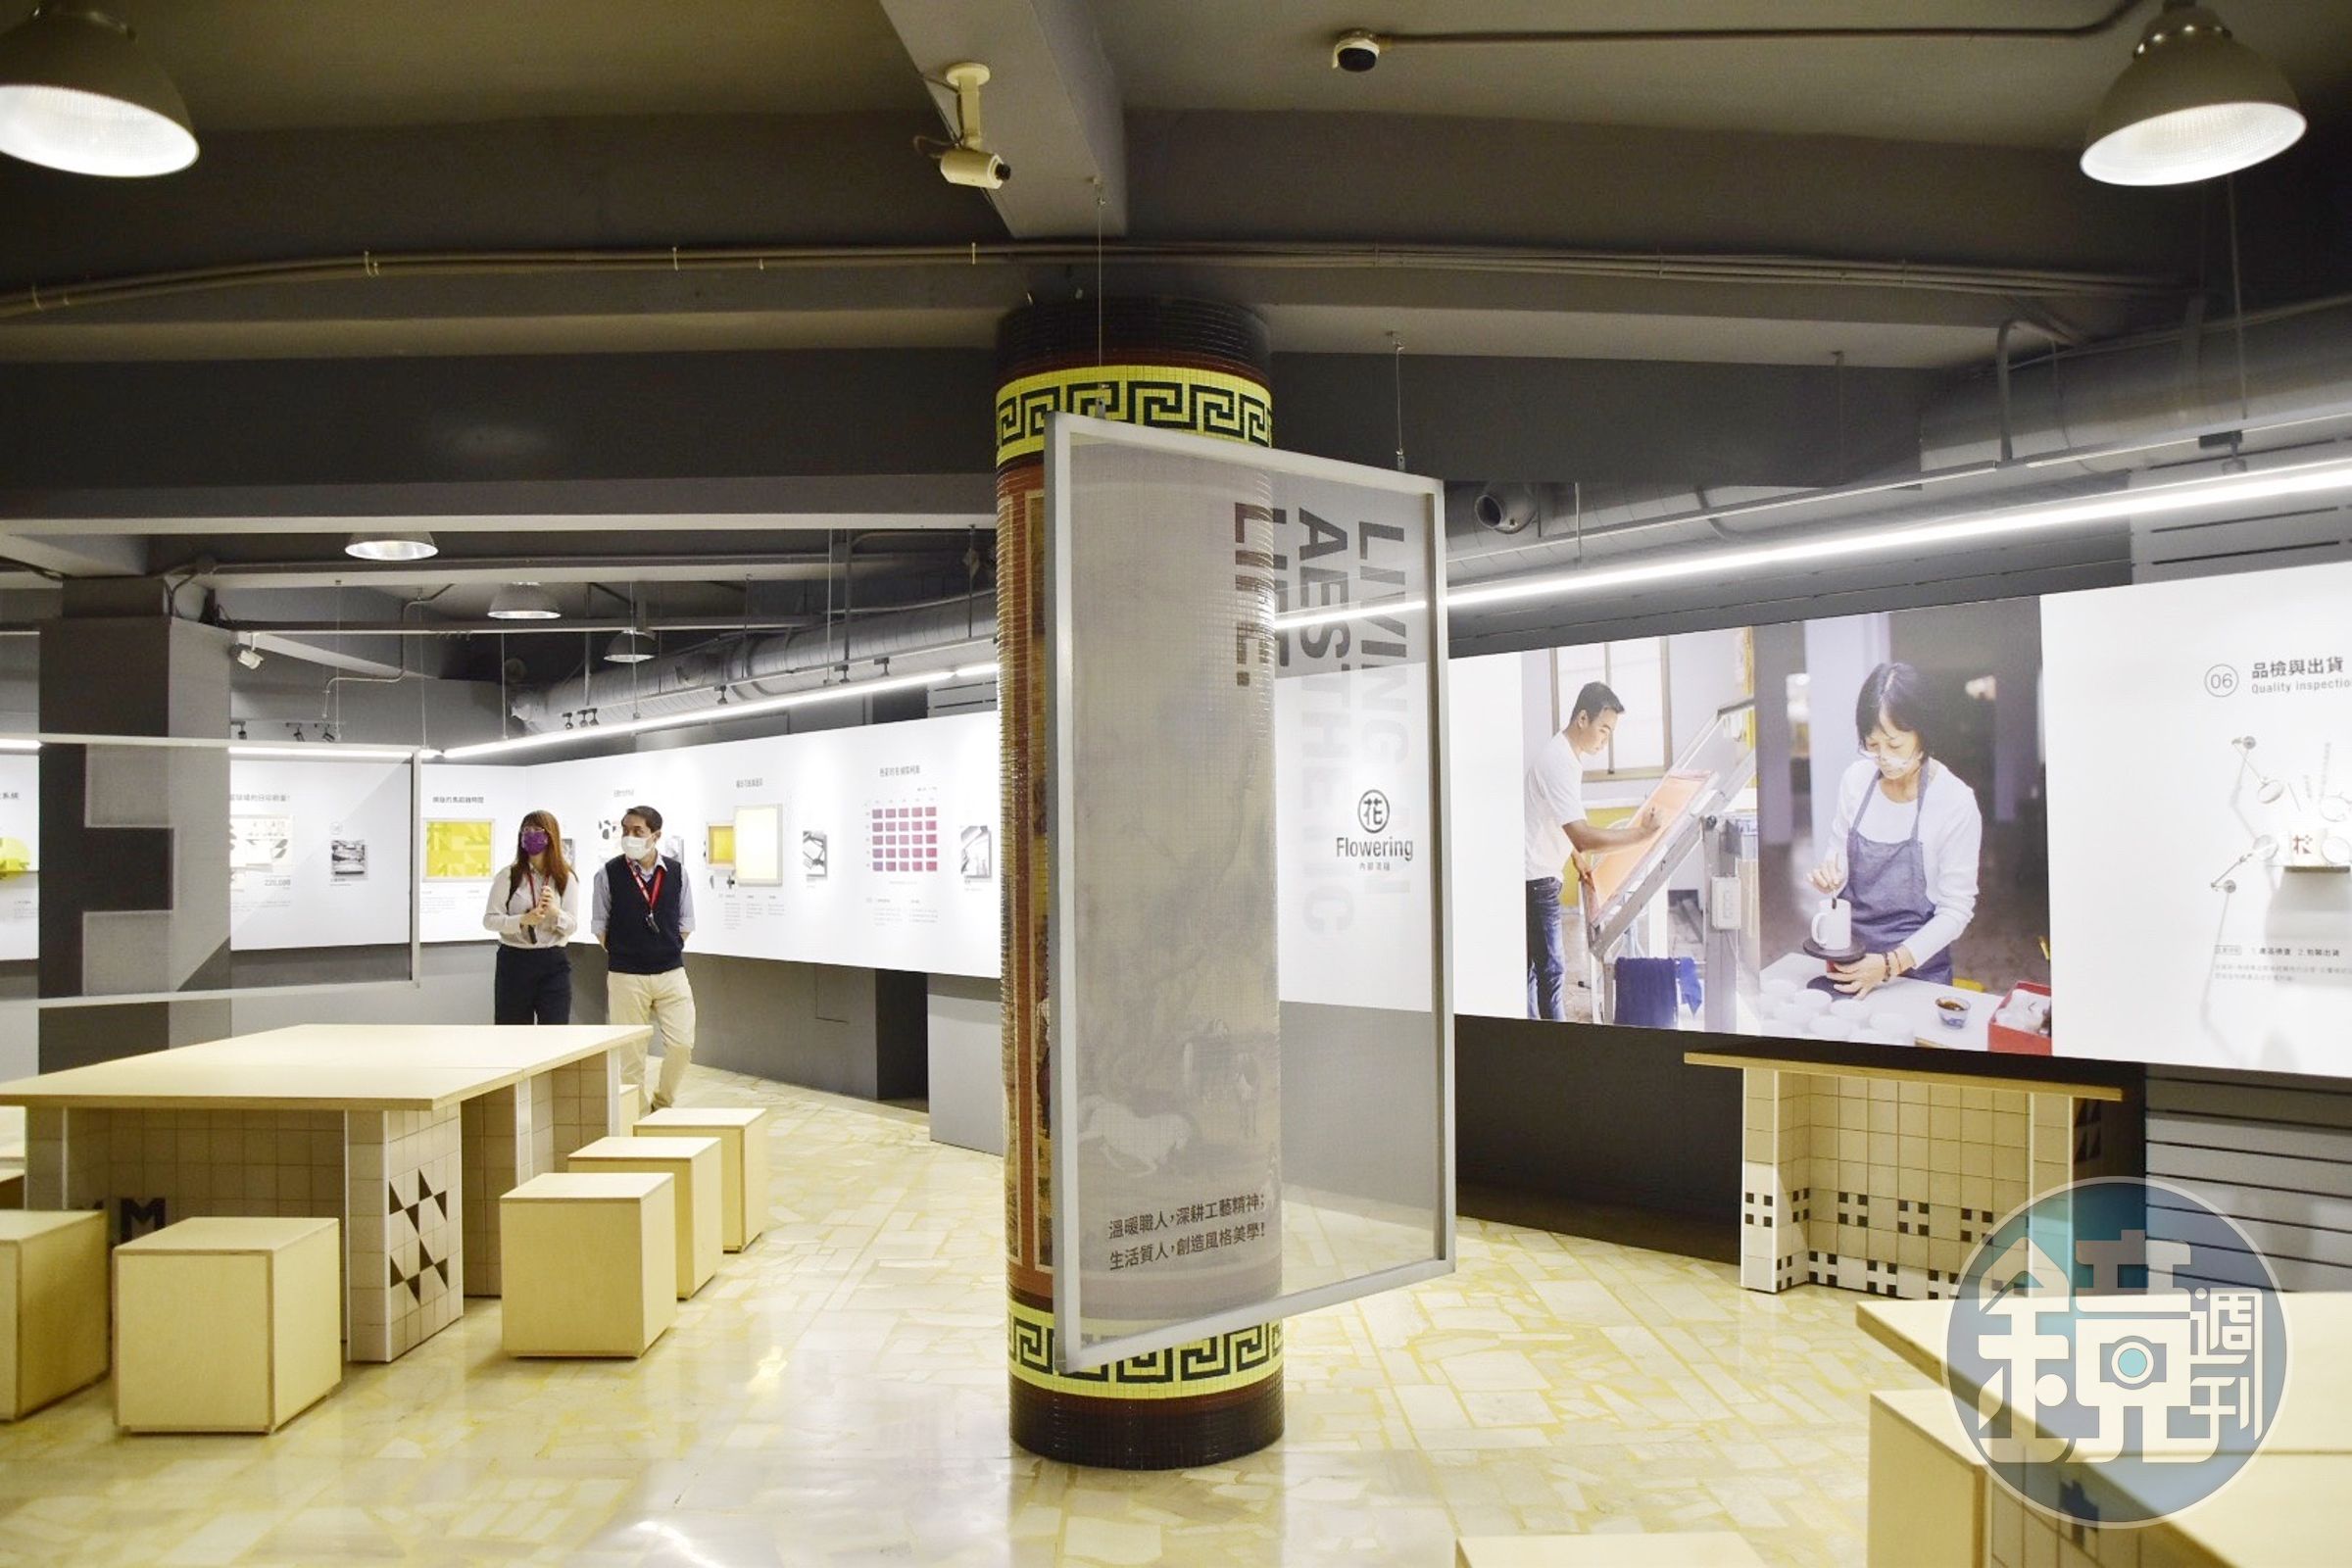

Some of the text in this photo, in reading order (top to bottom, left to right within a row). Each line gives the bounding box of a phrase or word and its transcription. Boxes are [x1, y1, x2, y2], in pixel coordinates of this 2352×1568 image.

[1358, 520, 1410, 767] LIVING
[2251, 656, 2344, 679] 品檢與出貨
[2210, 673, 2233, 689] 06
[2251, 682, 2291, 694] Quality
[1298, 507, 1355, 937] AESTHETIC
[1336, 835, 1414, 861] Flowering
